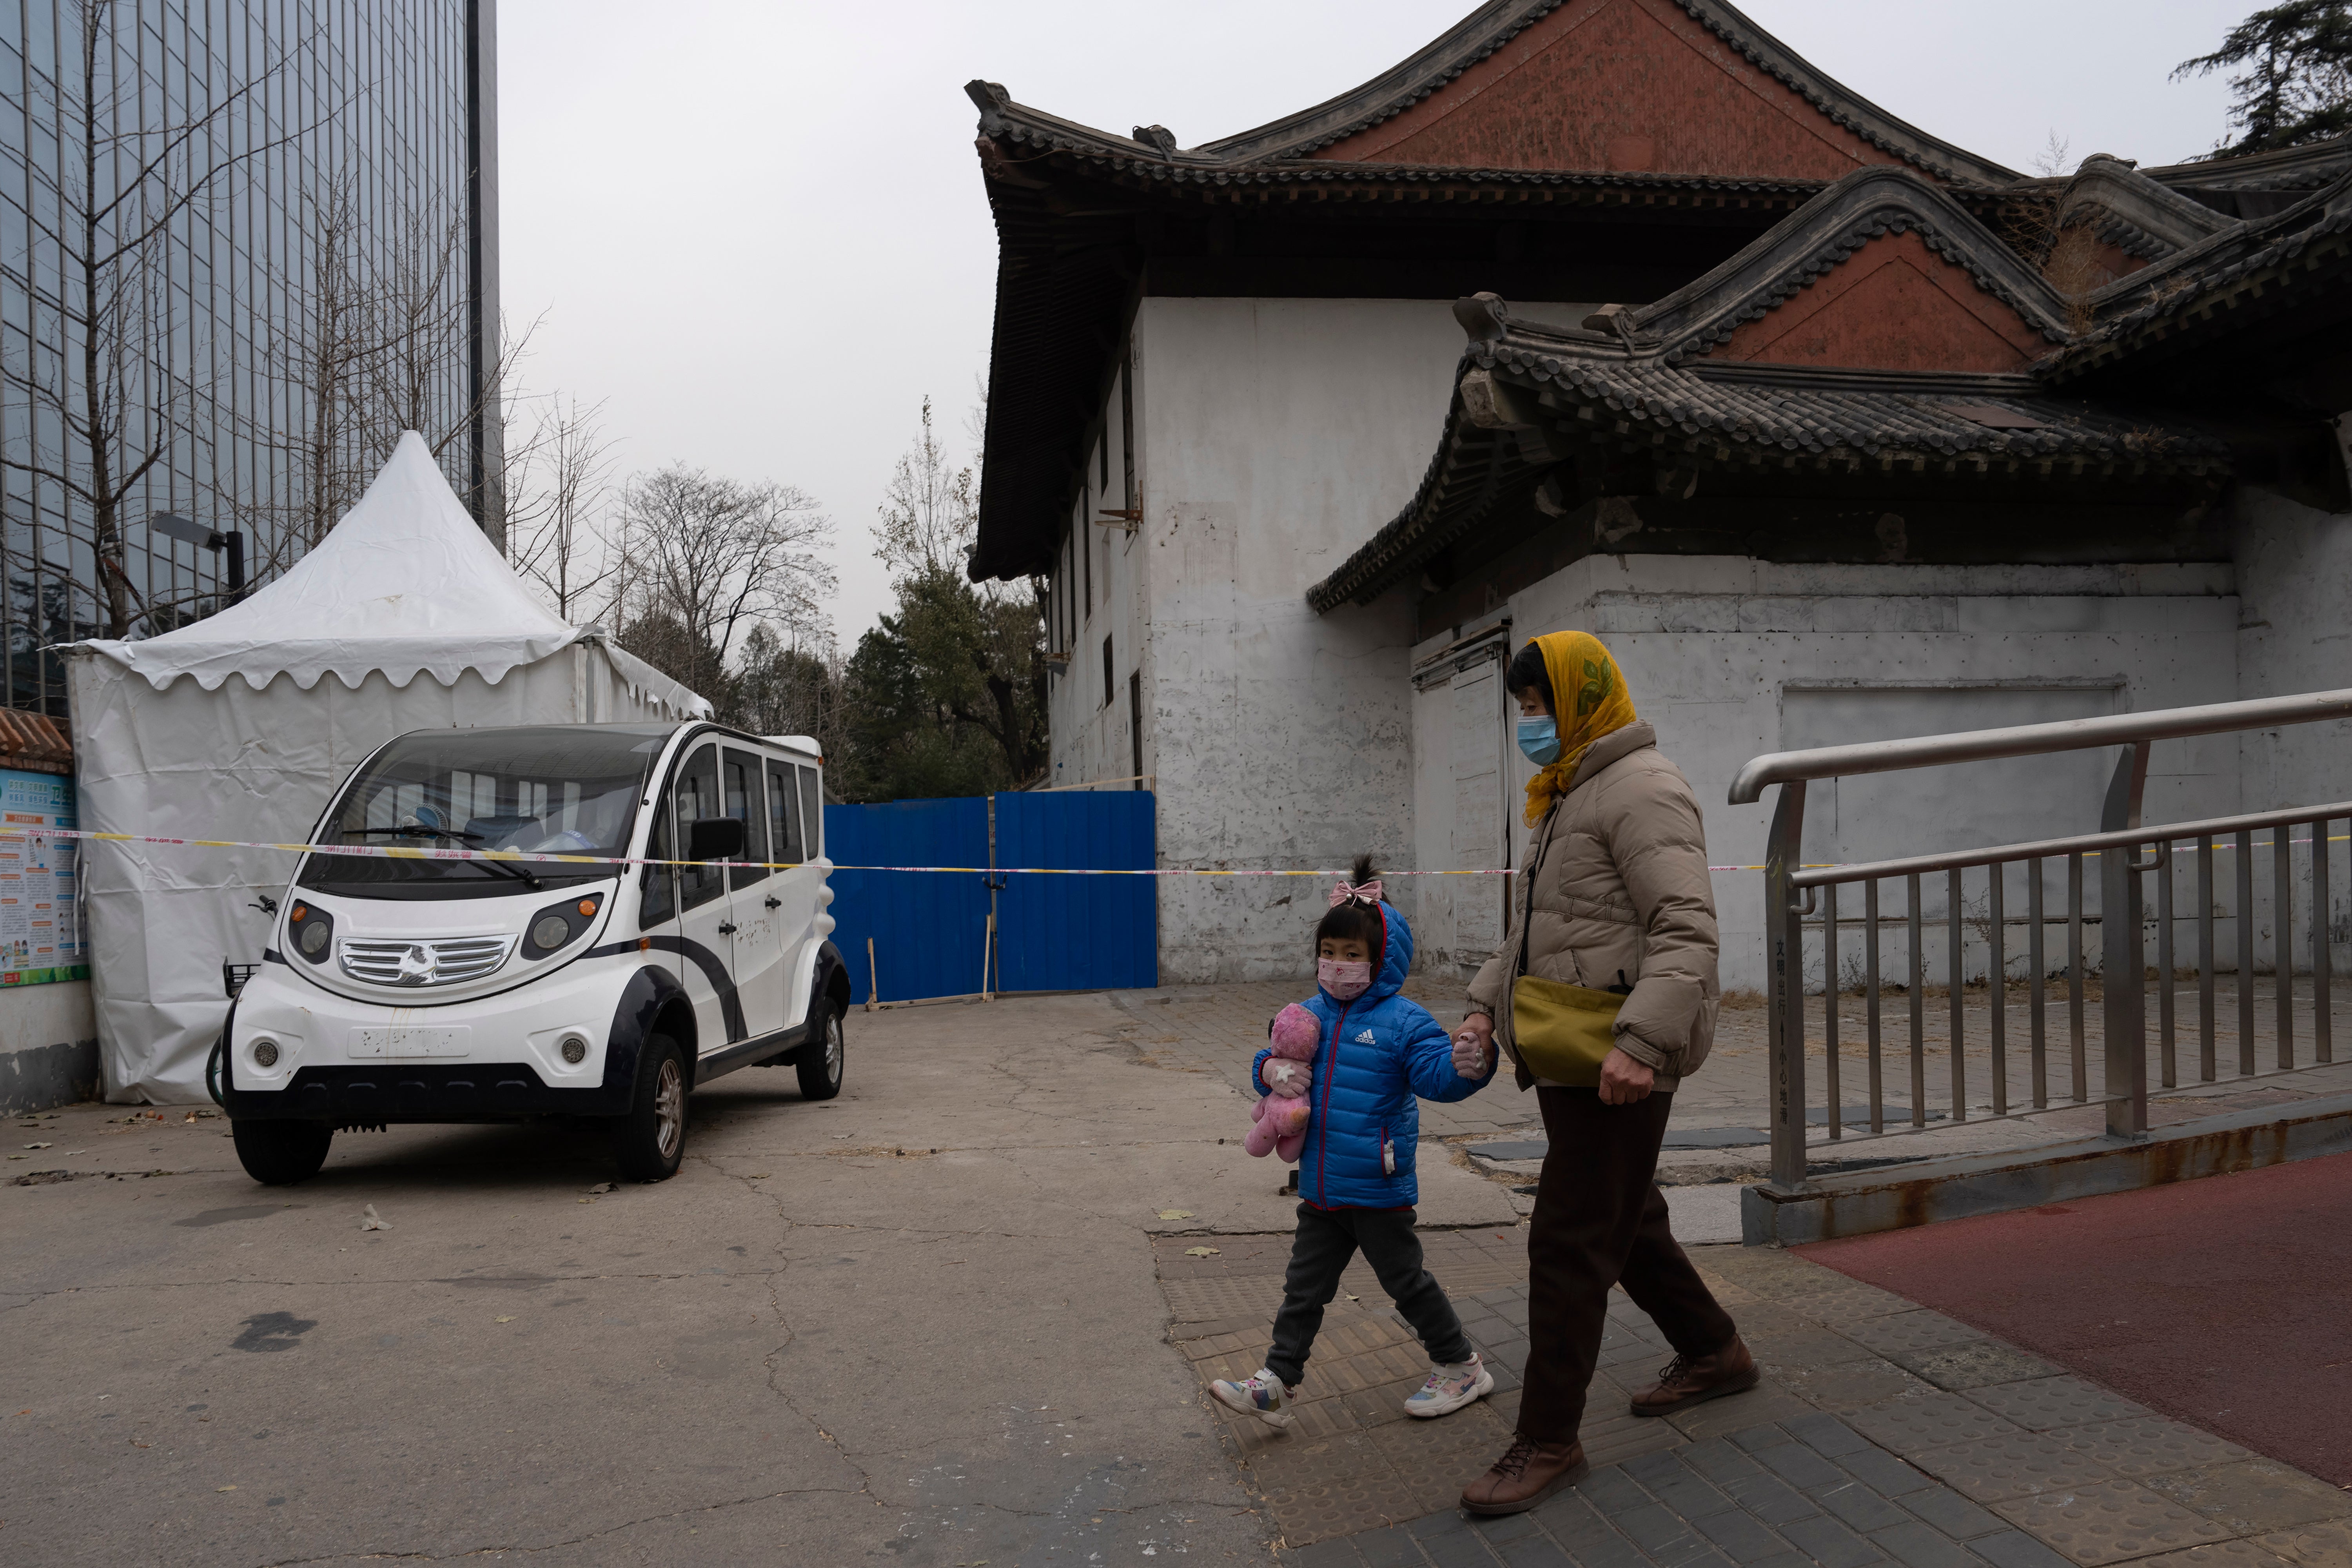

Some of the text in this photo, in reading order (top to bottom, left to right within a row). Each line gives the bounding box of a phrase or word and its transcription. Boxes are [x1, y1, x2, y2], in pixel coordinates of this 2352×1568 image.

[1777, 940, 1786, 1015] 文明出行
[1779, 1049, 1788, 1125] 小心地滑
